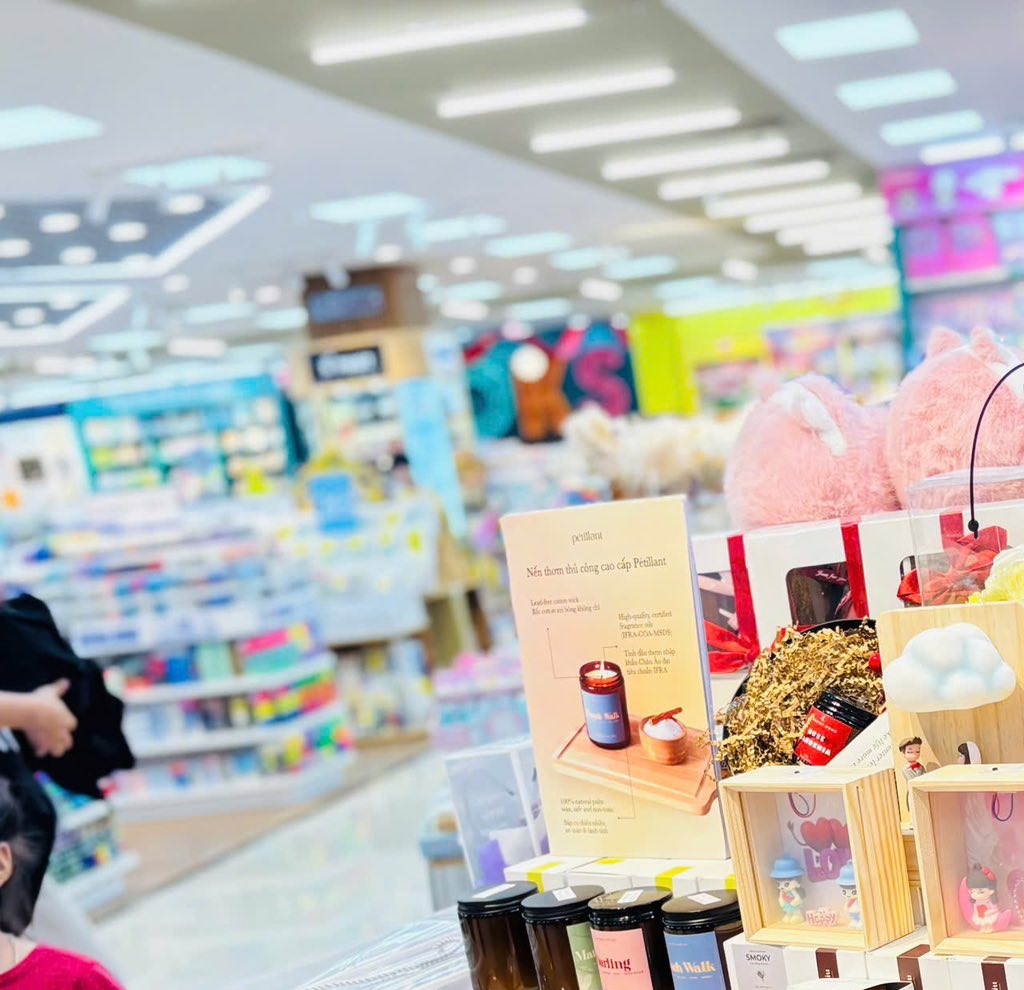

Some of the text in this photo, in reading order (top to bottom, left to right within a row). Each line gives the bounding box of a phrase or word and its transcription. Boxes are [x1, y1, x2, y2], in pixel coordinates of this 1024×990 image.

[580, 562, 599, 575] công
[601, 563, 615, 572] cao
[617, 556, 632, 572] cấp
[746, 954, 771, 962] SMOKY
[684, 960, 717, 973] Walk
